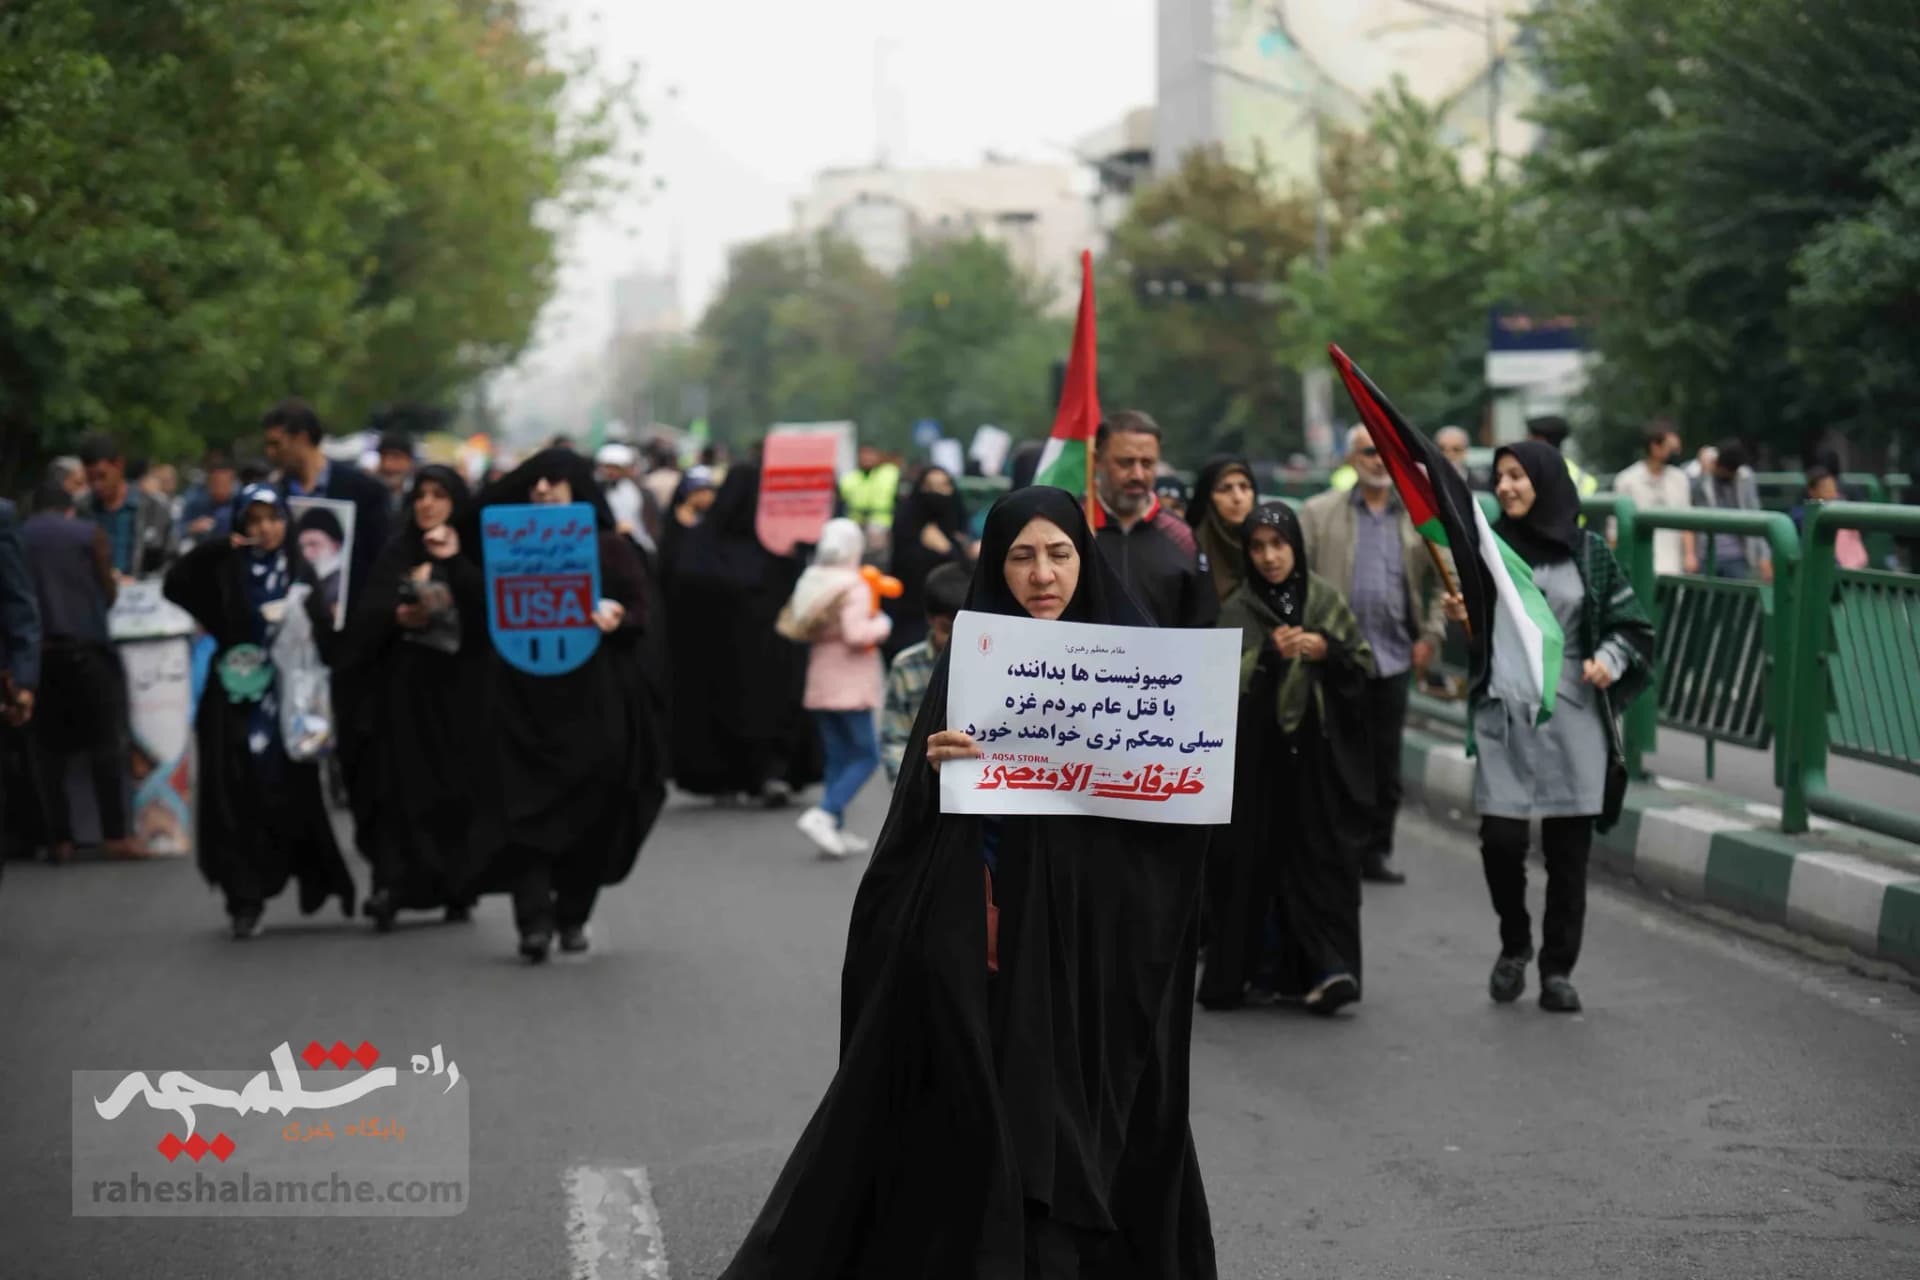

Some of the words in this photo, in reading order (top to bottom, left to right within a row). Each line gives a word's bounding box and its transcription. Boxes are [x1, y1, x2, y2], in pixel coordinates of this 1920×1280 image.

[505, 589, 586, 624] USA
[1007, 660, 1066, 685] بدانند،
[1071, 663, 1089, 682] ها
[1094, 666, 1183, 690] صهیونیست
[1005, 692, 1036, 715] غزه
[1042, 698, 1087, 718] مردم
[1091, 696, 1122, 719] عام
[1126, 697, 1158, 720] قتل
[1163, 699, 1176, 721] با
[1017, 723, 1081, 747] خواهند
[1086, 729, 1122, 750] تری
[1125, 730, 1174, 751] محکم
[1179, 731, 1224, 754] سیلی
[991, 753, 1016, 762] AQSA
[1017, 754, 1050, 764] STORM
